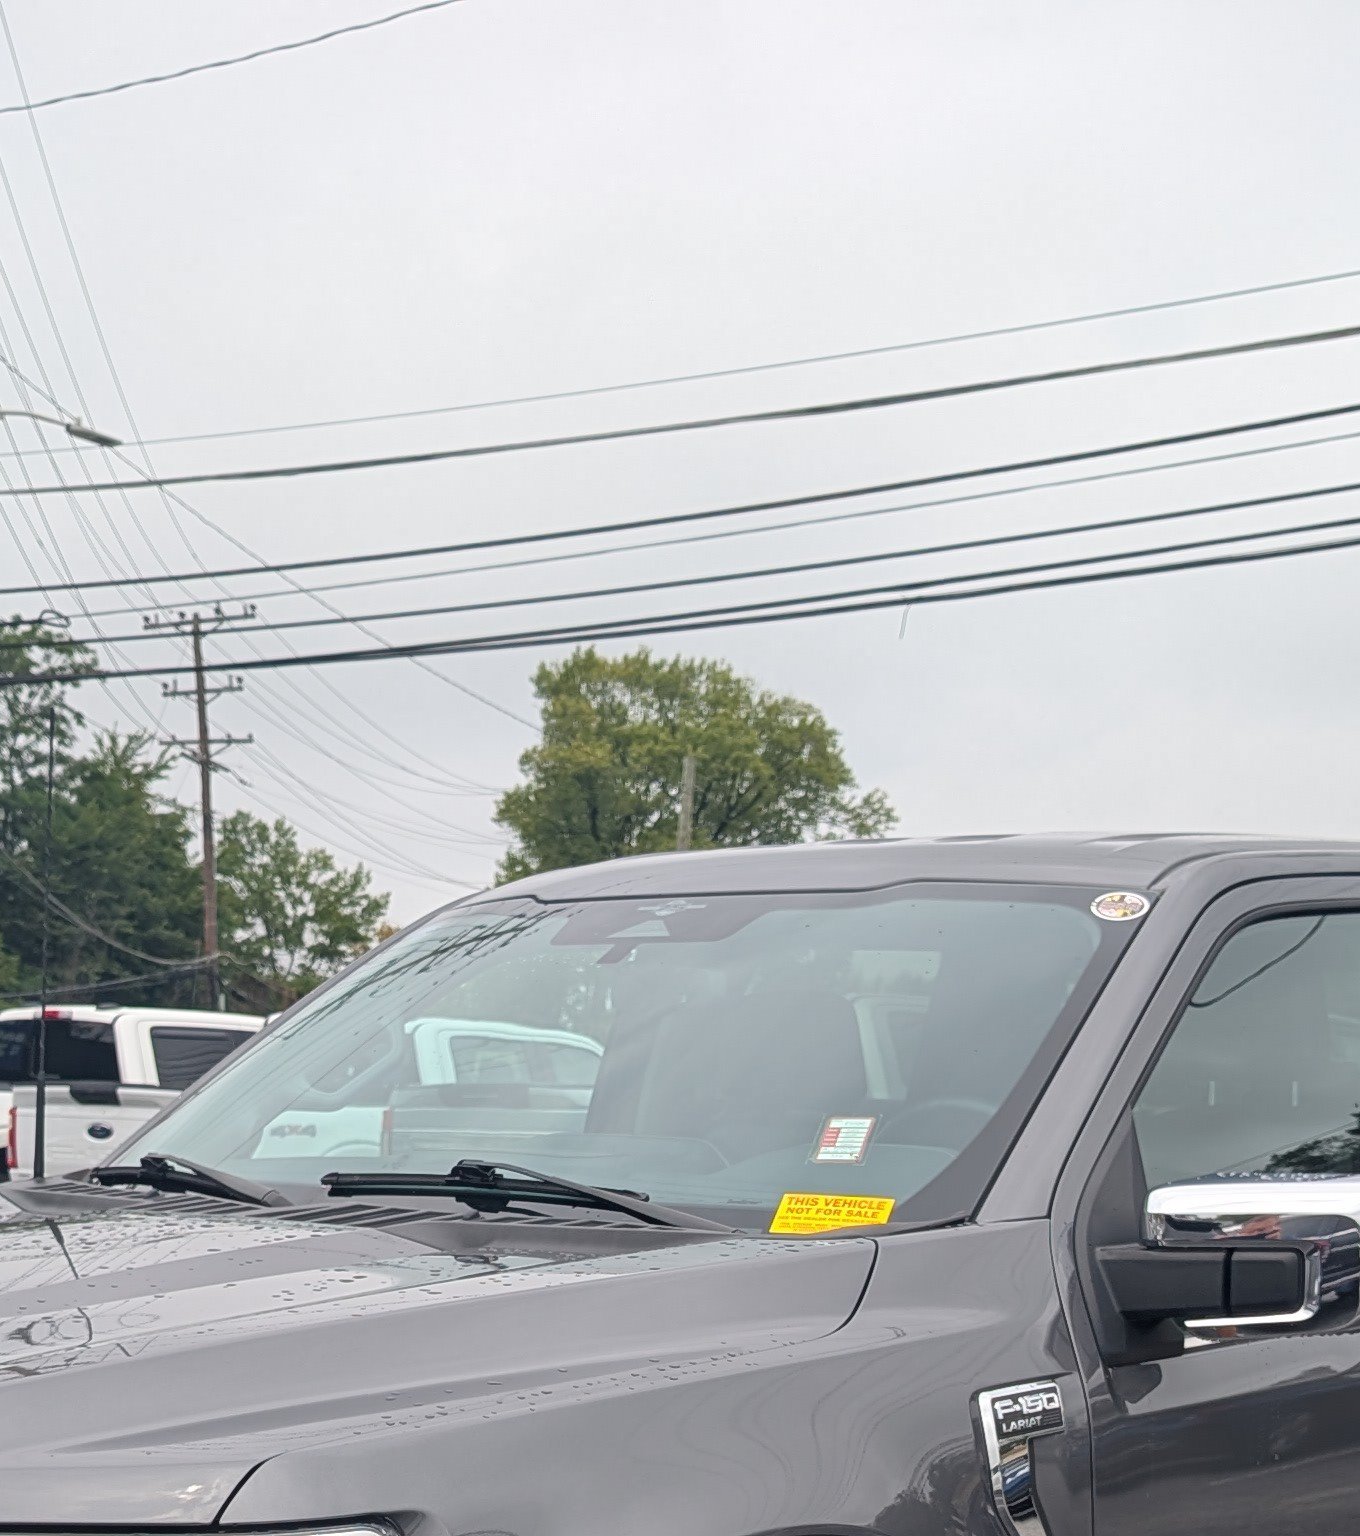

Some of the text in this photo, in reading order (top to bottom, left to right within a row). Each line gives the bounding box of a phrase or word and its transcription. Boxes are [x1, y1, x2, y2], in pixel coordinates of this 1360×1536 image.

[786, 1196, 887, 1211] THIS VEHICLE
[785, 1207, 812, 1216] NOT
[815, 1208, 842, 1217] FOR
[845, 1209, 880, 1219] SALE
[1001, 1415, 1043, 1434] LARIAT
